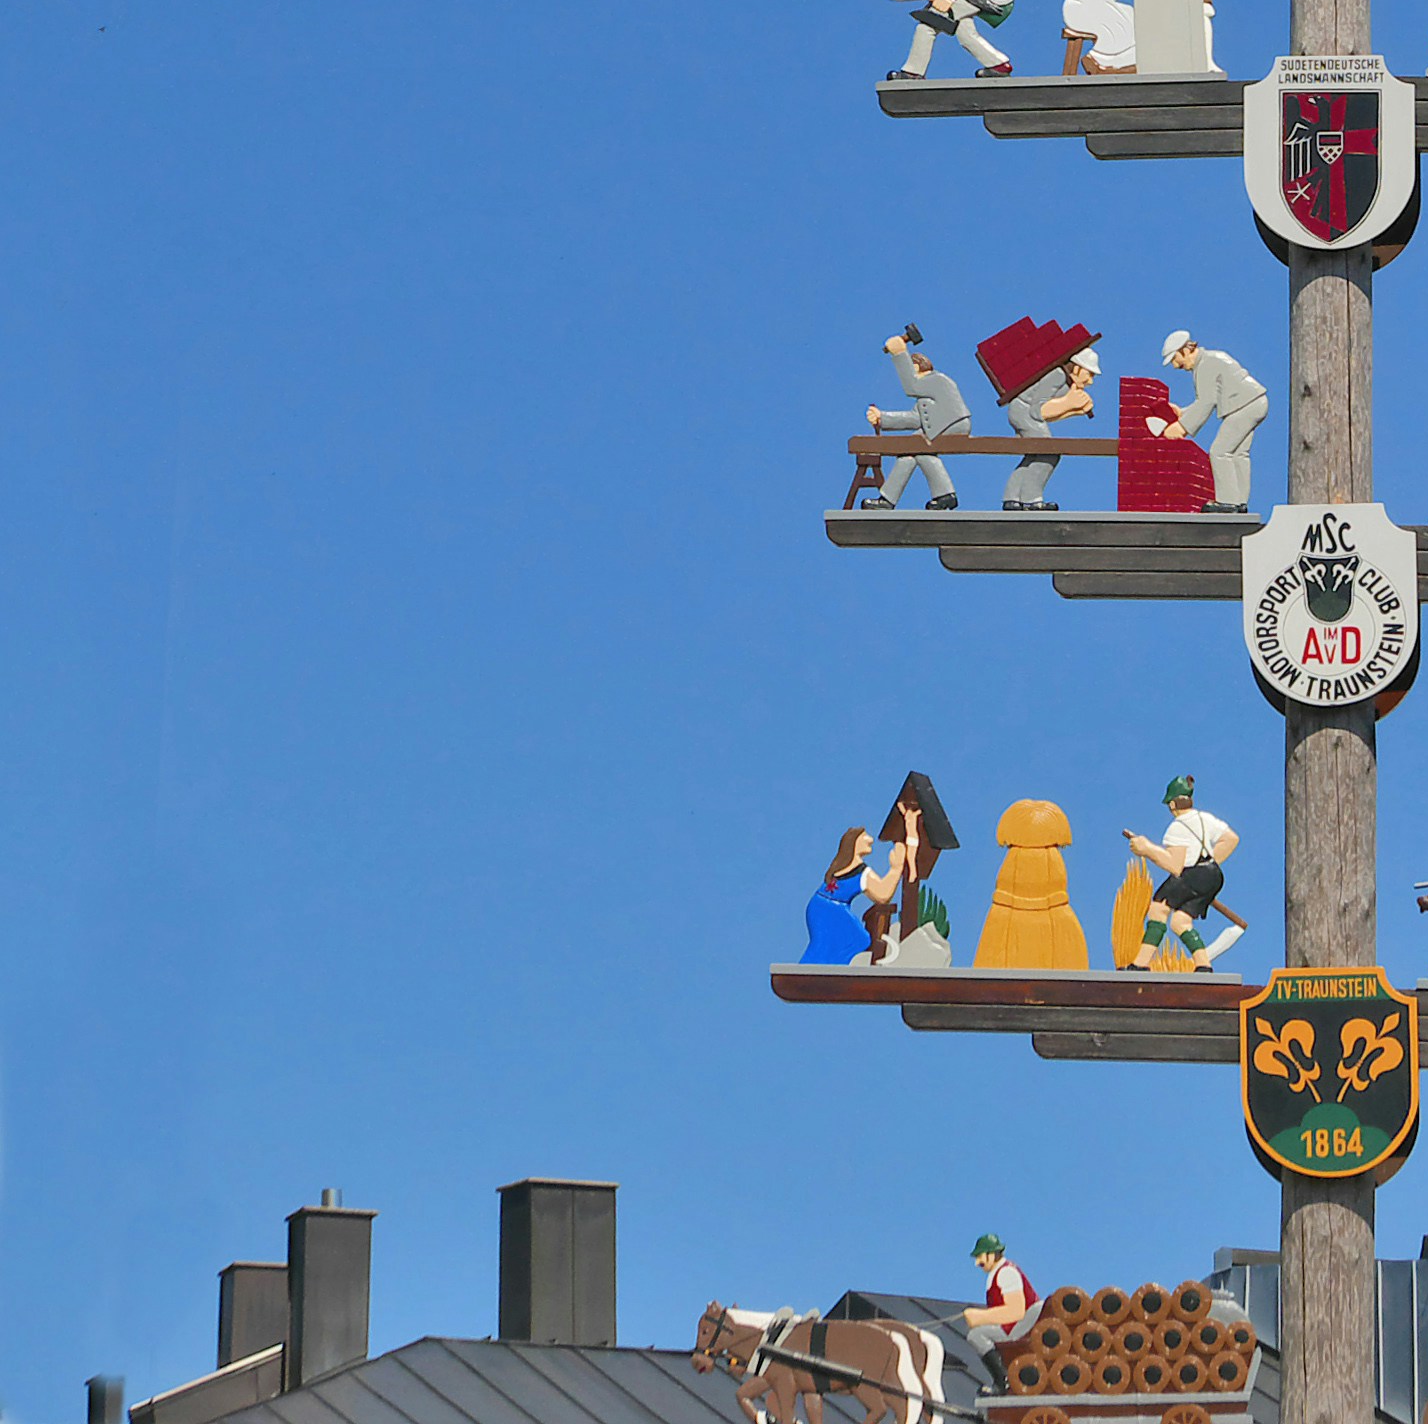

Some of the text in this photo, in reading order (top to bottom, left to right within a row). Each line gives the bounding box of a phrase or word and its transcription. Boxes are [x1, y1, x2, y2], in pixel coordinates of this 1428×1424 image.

[1278, 72, 1384, 84] LANDSMANNSCHAFT
[1280, 58, 1380, 72] SUDETENDEUTSCHE
[1301, 512, 1356, 554] MSC
[1256, 566, 1401, 689] MOTORSPORT CLUB
[1306, 623, 1404, 700] TRAUNSTEIN
[1276, 977, 1377, 999] TV-TRAUNSTEIN
[1300, 1127, 1364, 1158] 1864
